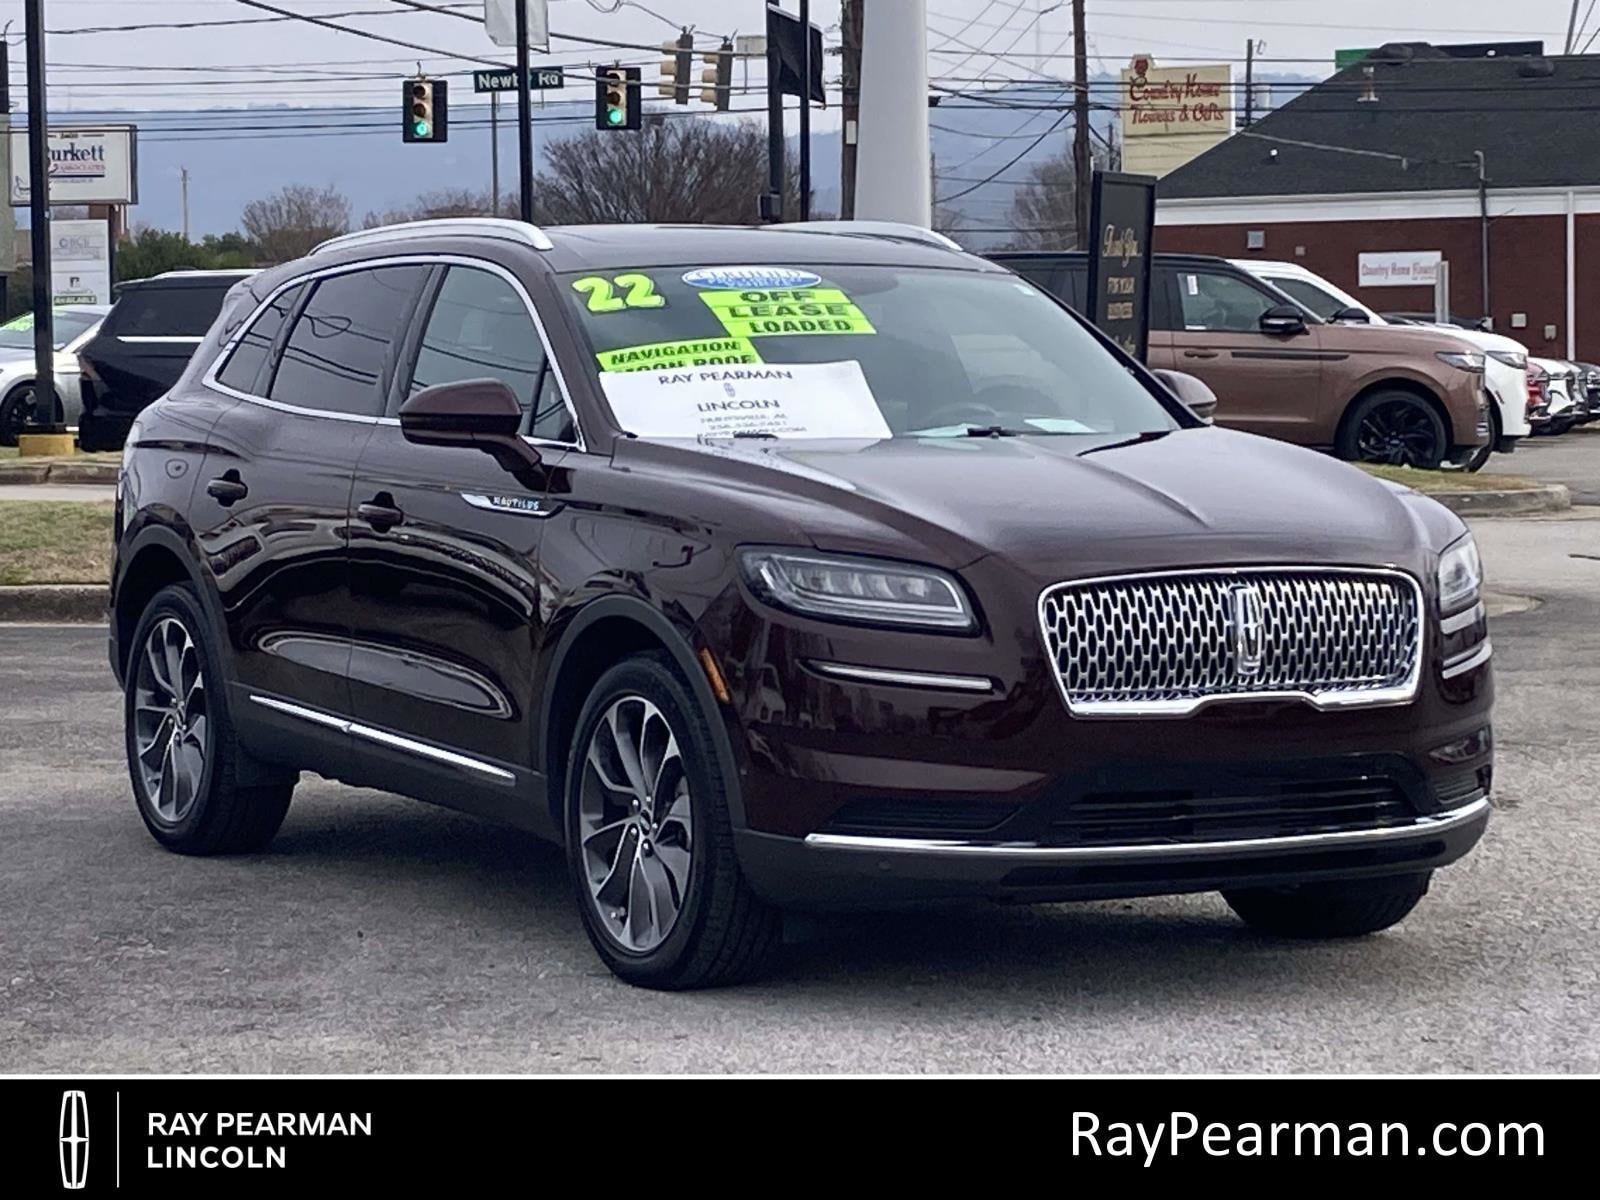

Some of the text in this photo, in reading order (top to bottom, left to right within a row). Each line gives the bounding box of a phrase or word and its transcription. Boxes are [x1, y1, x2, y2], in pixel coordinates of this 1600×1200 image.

[478, 73, 559, 88] Newb Rd
[48, 142, 104, 161] urkett
[572, 274, 665, 312] 22
[739, 291, 816, 303] OFF
[728, 304, 851, 318] LEASE
[749, 319, 854, 333] LOADED
[611, 341, 741, 365] NAVIGATION
[658, 371, 793, 385] RAY PEARMAN
[697, 399, 780, 412] LINCOLN
[493, 496, 539, 510] NAUTILUS
